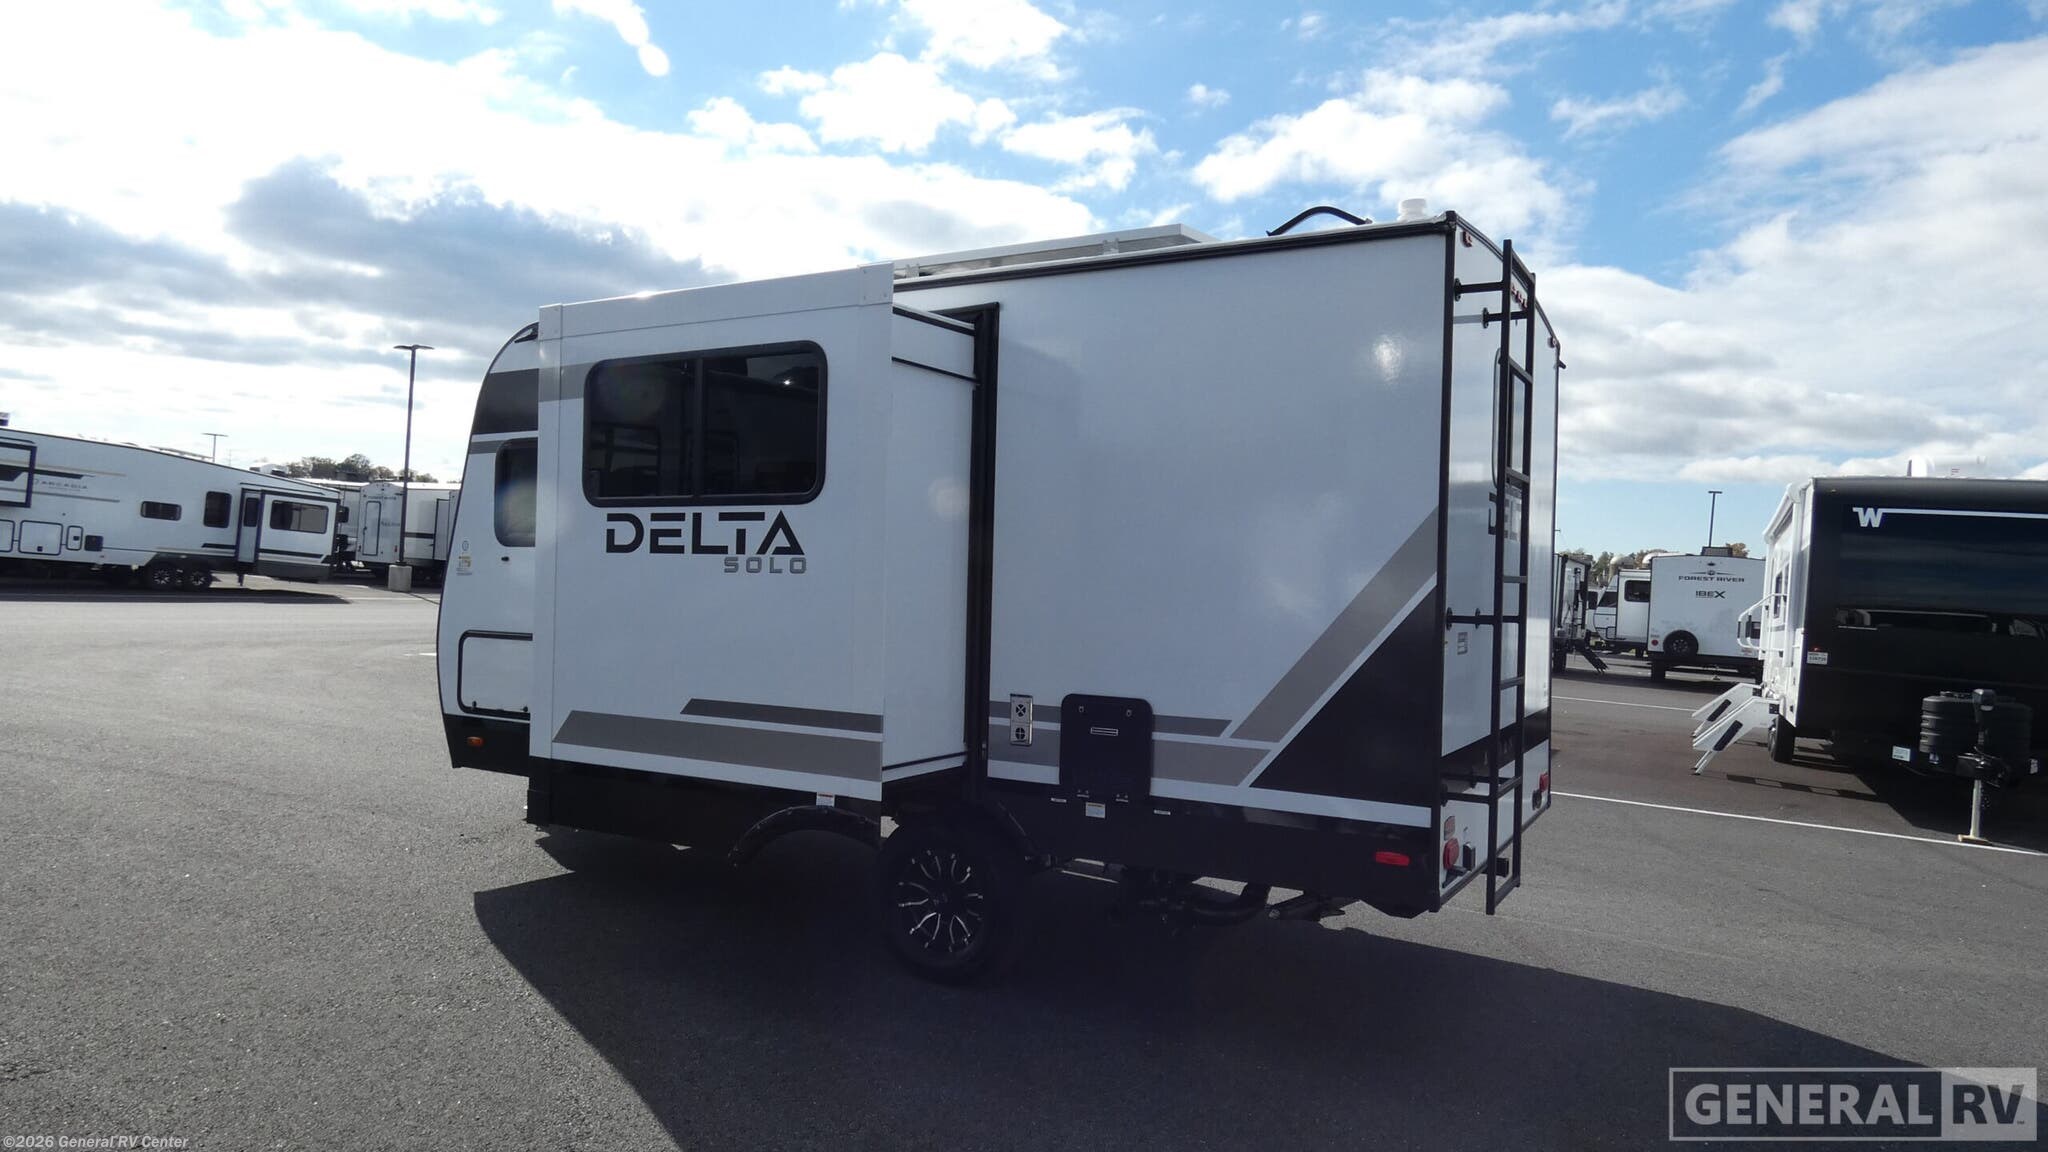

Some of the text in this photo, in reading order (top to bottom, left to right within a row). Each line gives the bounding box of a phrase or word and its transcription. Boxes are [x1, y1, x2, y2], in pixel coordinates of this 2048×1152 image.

[606, 509, 805, 555] DELTA
[723, 556, 807, 574] SOLO
[1695, 590, 1726, 599] IBEX
